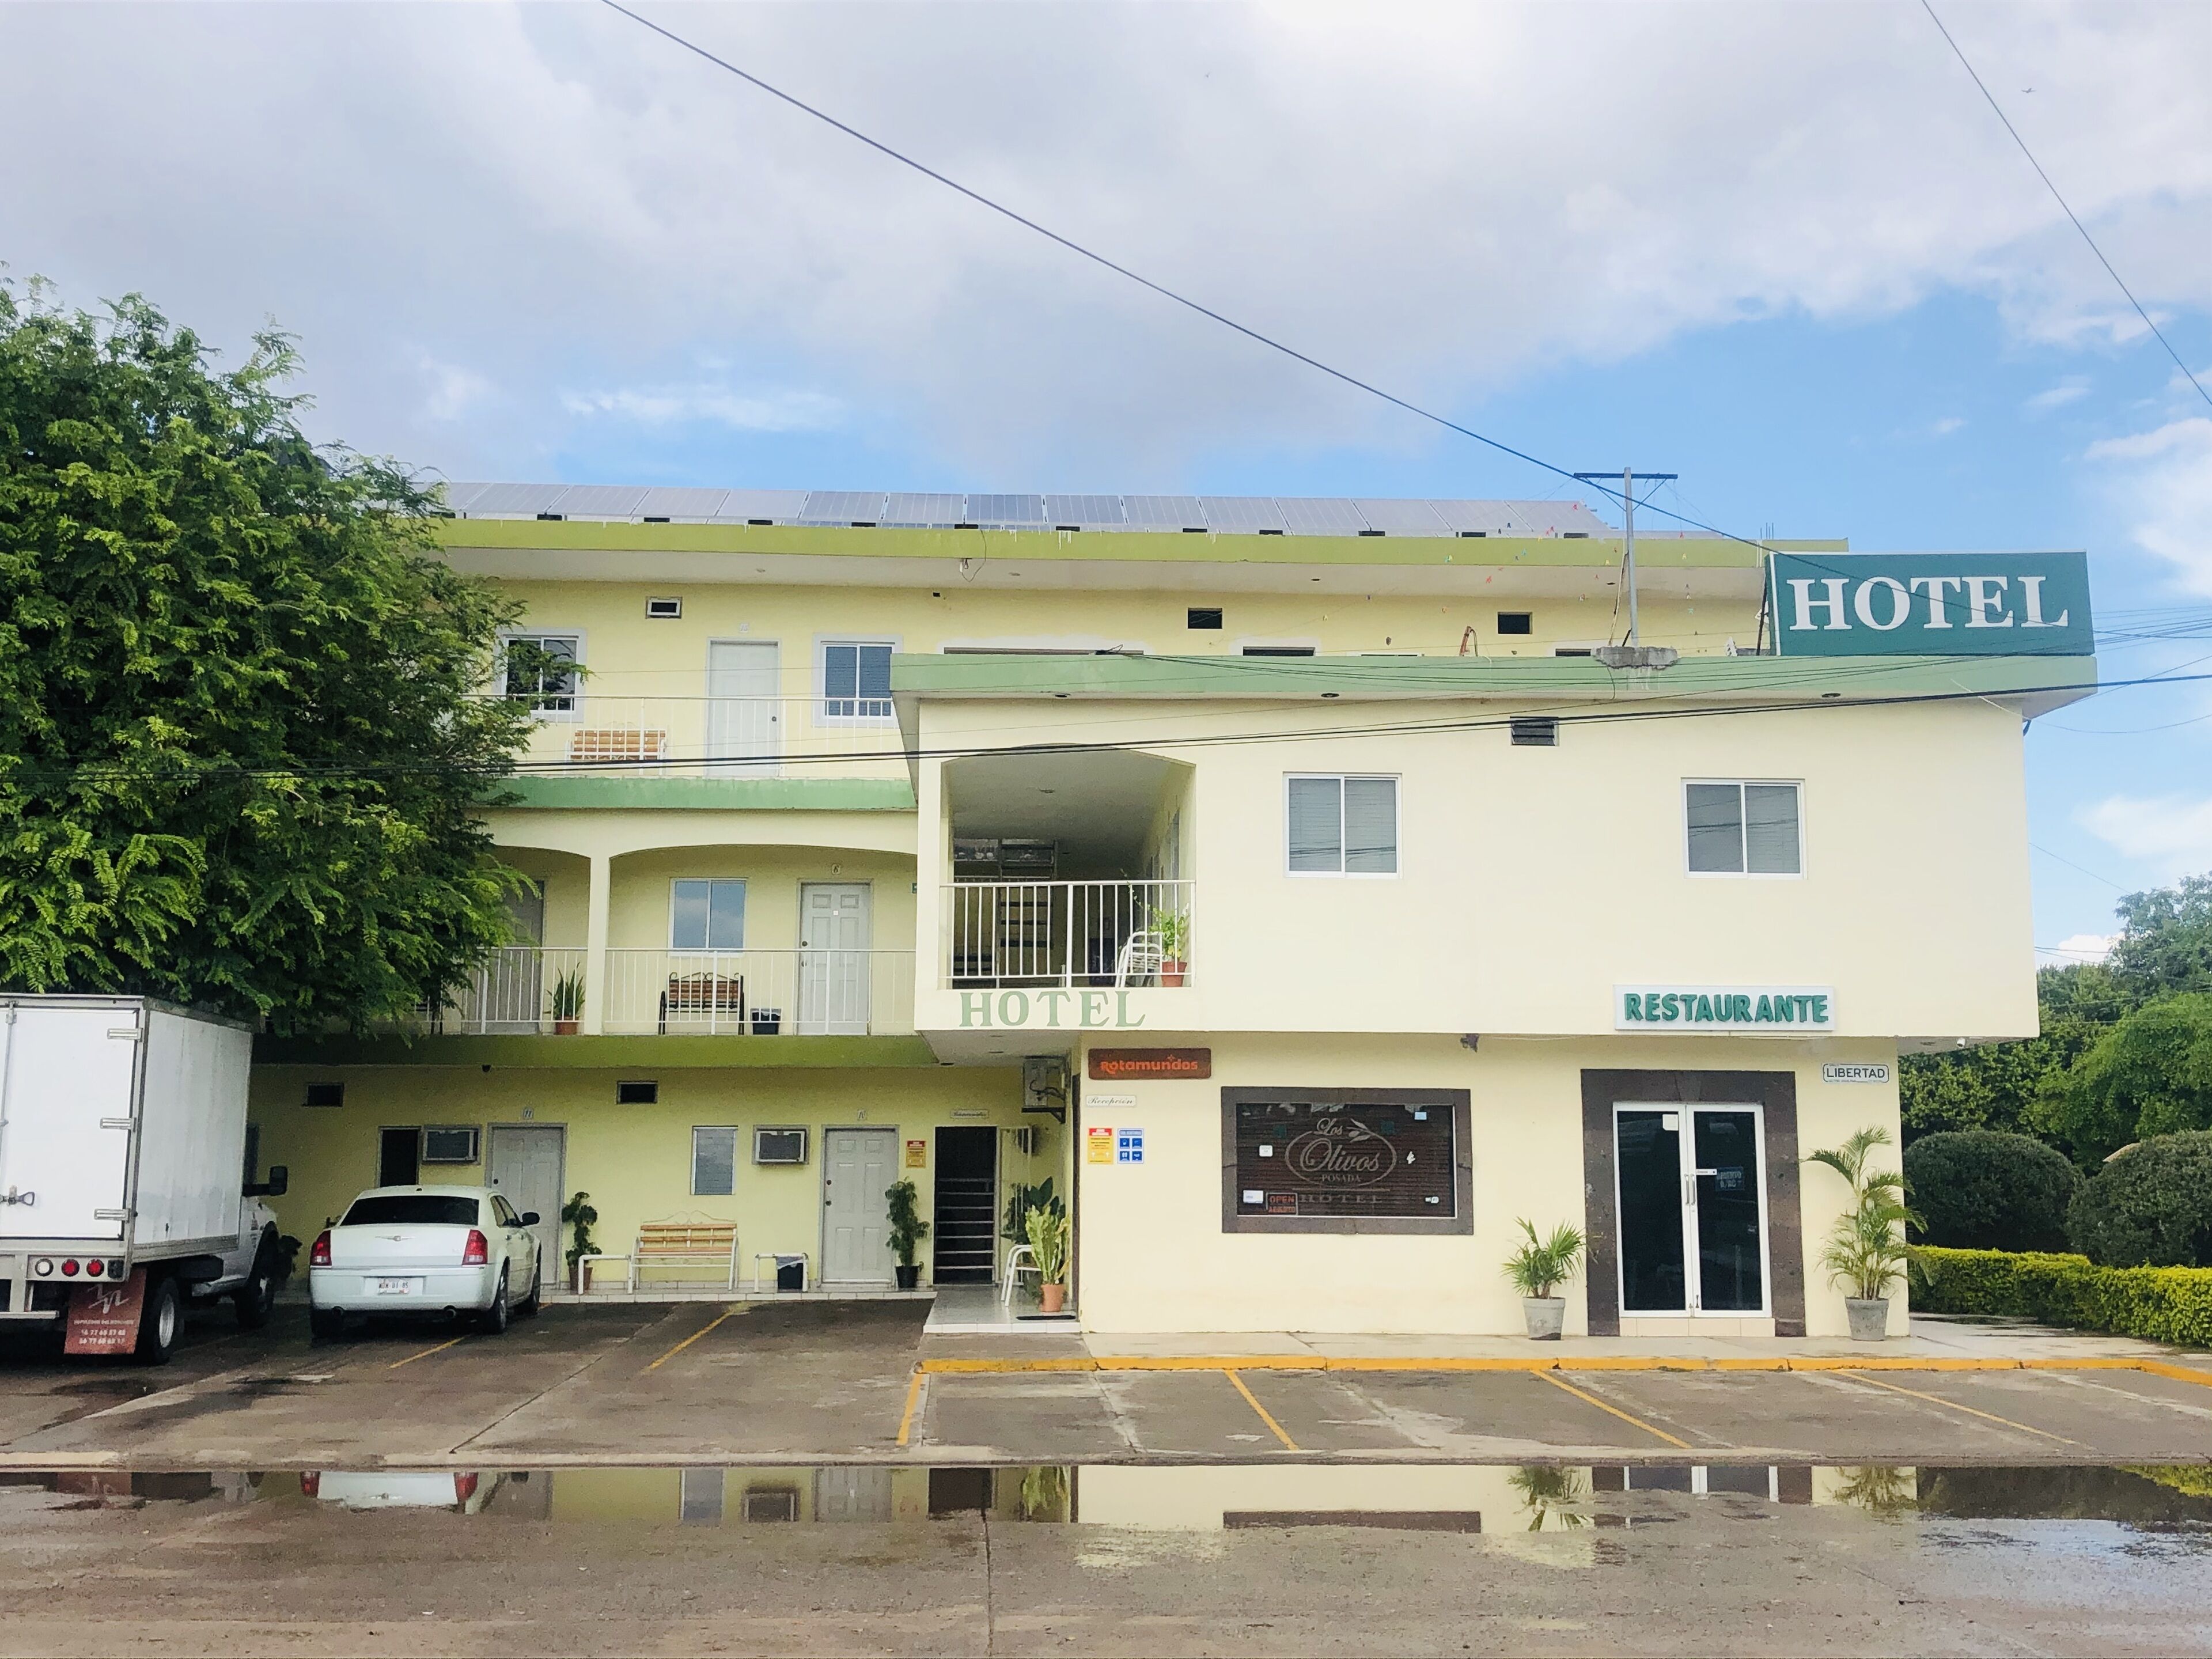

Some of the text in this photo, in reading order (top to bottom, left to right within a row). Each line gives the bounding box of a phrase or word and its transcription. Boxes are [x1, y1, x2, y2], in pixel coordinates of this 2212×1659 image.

[1786, 576, 2069, 631] HOTEL
[959, 991, 1146, 1027] HOTEL
[1624, 993, 1829, 1023] RESTAURANTE
[1827, 1067, 1885, 1078] LIBERTAD
[1314, 1118, 1343, 1136] Los
[1300, 1138, 1380, 1172] Olivos
[1321, 1174, 1362, 1182] POSADA
[1270, 1195, 1295, 1203] OPEN
[1298, 1194, 1382, 1203] HOTEL
